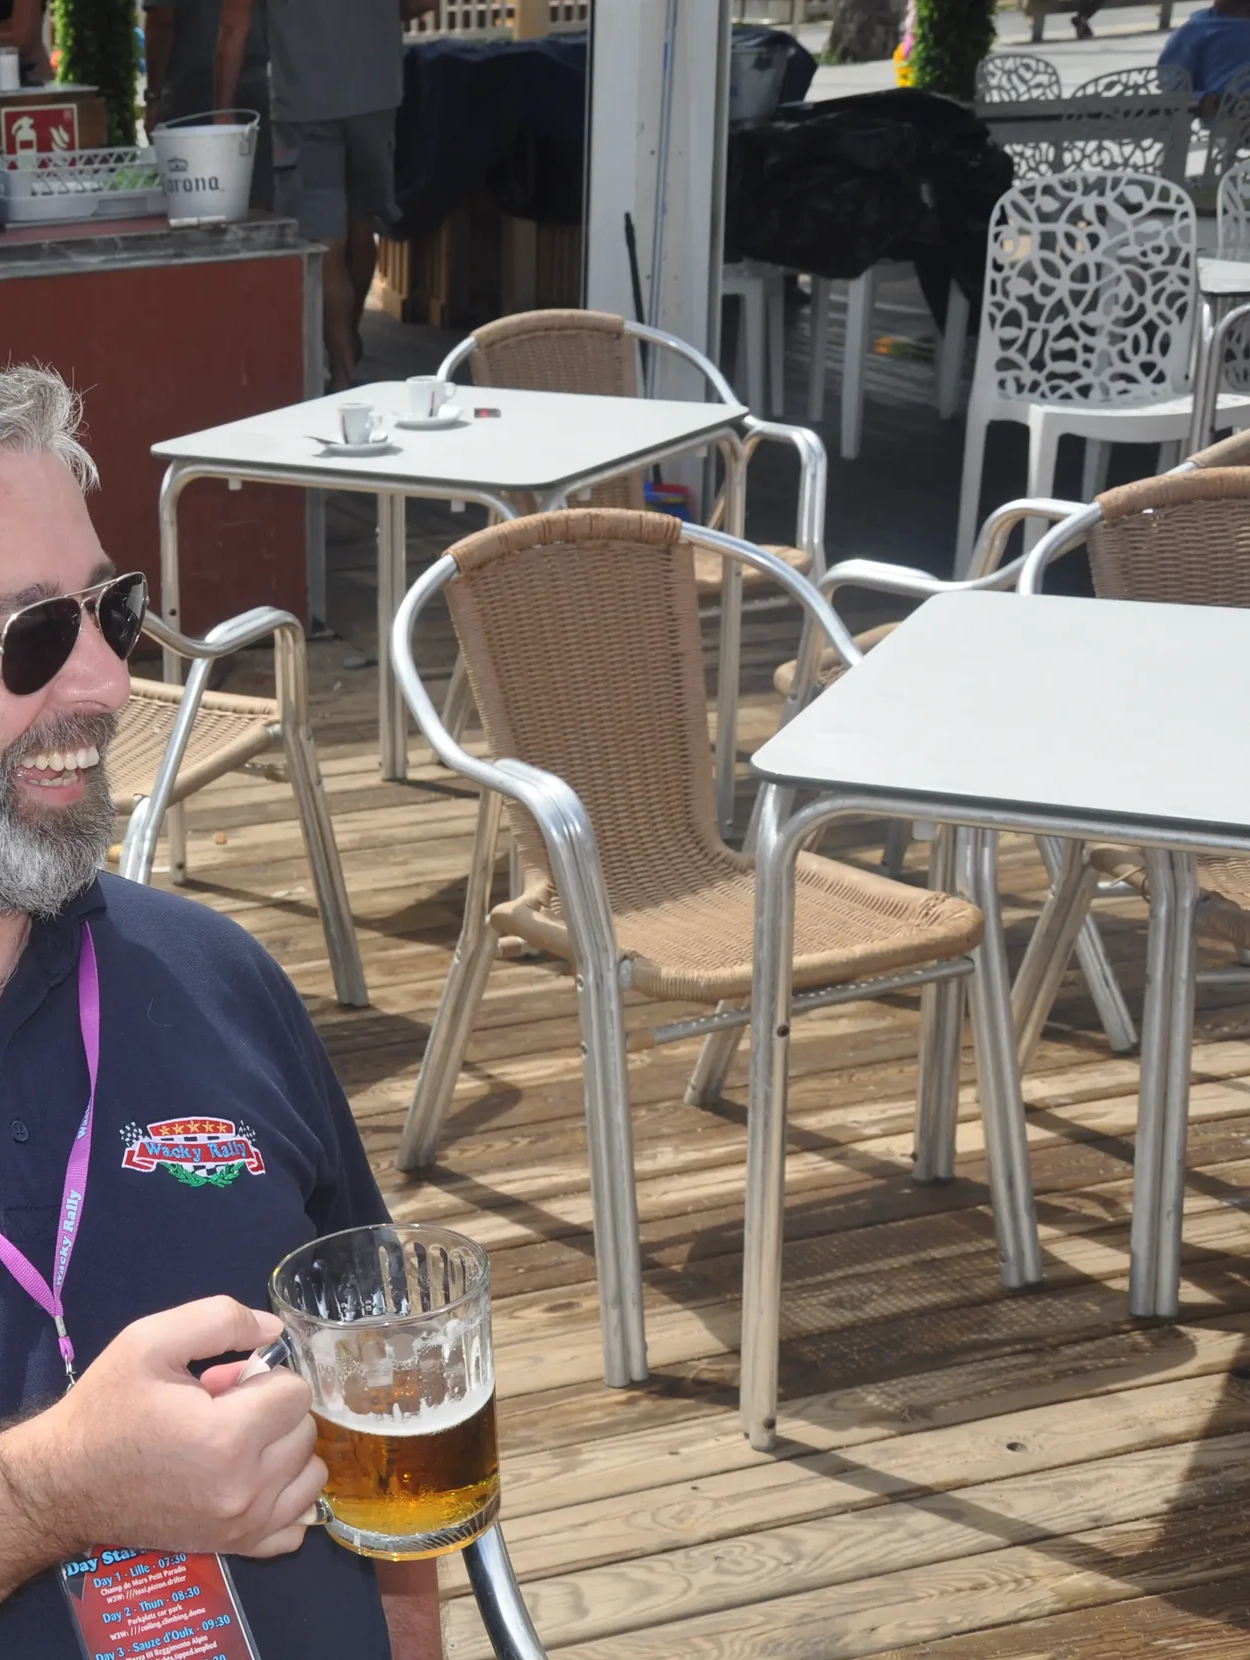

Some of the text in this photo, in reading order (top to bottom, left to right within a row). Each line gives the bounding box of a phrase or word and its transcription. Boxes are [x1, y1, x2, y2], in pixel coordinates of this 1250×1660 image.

[144, 1141, 246, 1163] Wacky Rally
[56, 1189, 82, 1286] Wacky Rally
[67, 1558, 98, 1576] Day
[93, 1576, 113, 1588] Day
[115, 1572, 121, 1581] 1
[130, 1564, 150, 1577] Lille
[158, 1553, 187, 1568] 07:30
[101, 1585, 122, 1596] Champ
[132, 1577, 148, 1587] Mars
[149, 1573, 163, 1582] Petit
[163, 1565, 187, 1578] Paradis
[102, 1611, 122, 1623] Day
[124, 1607, 131, 1617] 2
[139, 1598, 164, 1612] Thun
[171, 1586, 200, 1602] 08:30
[106, 1593, 125, 1604] W3W:
[127, 1613, 156, 1626] Parkplatz
[168, 1603, 183, 1615] park
[95, 1651, 115, 1660] Day
[117, 1647, 124, 1657] 3
[132, 1637, 161, 1652] Sauze
[163, 1626, 194, 1643] d'Oulx
[202, 1614, 231, 1631] 09:30
[110, 1630, 129, 1641] W3W:
[154, 1641, 191, 1656] Reggimento
